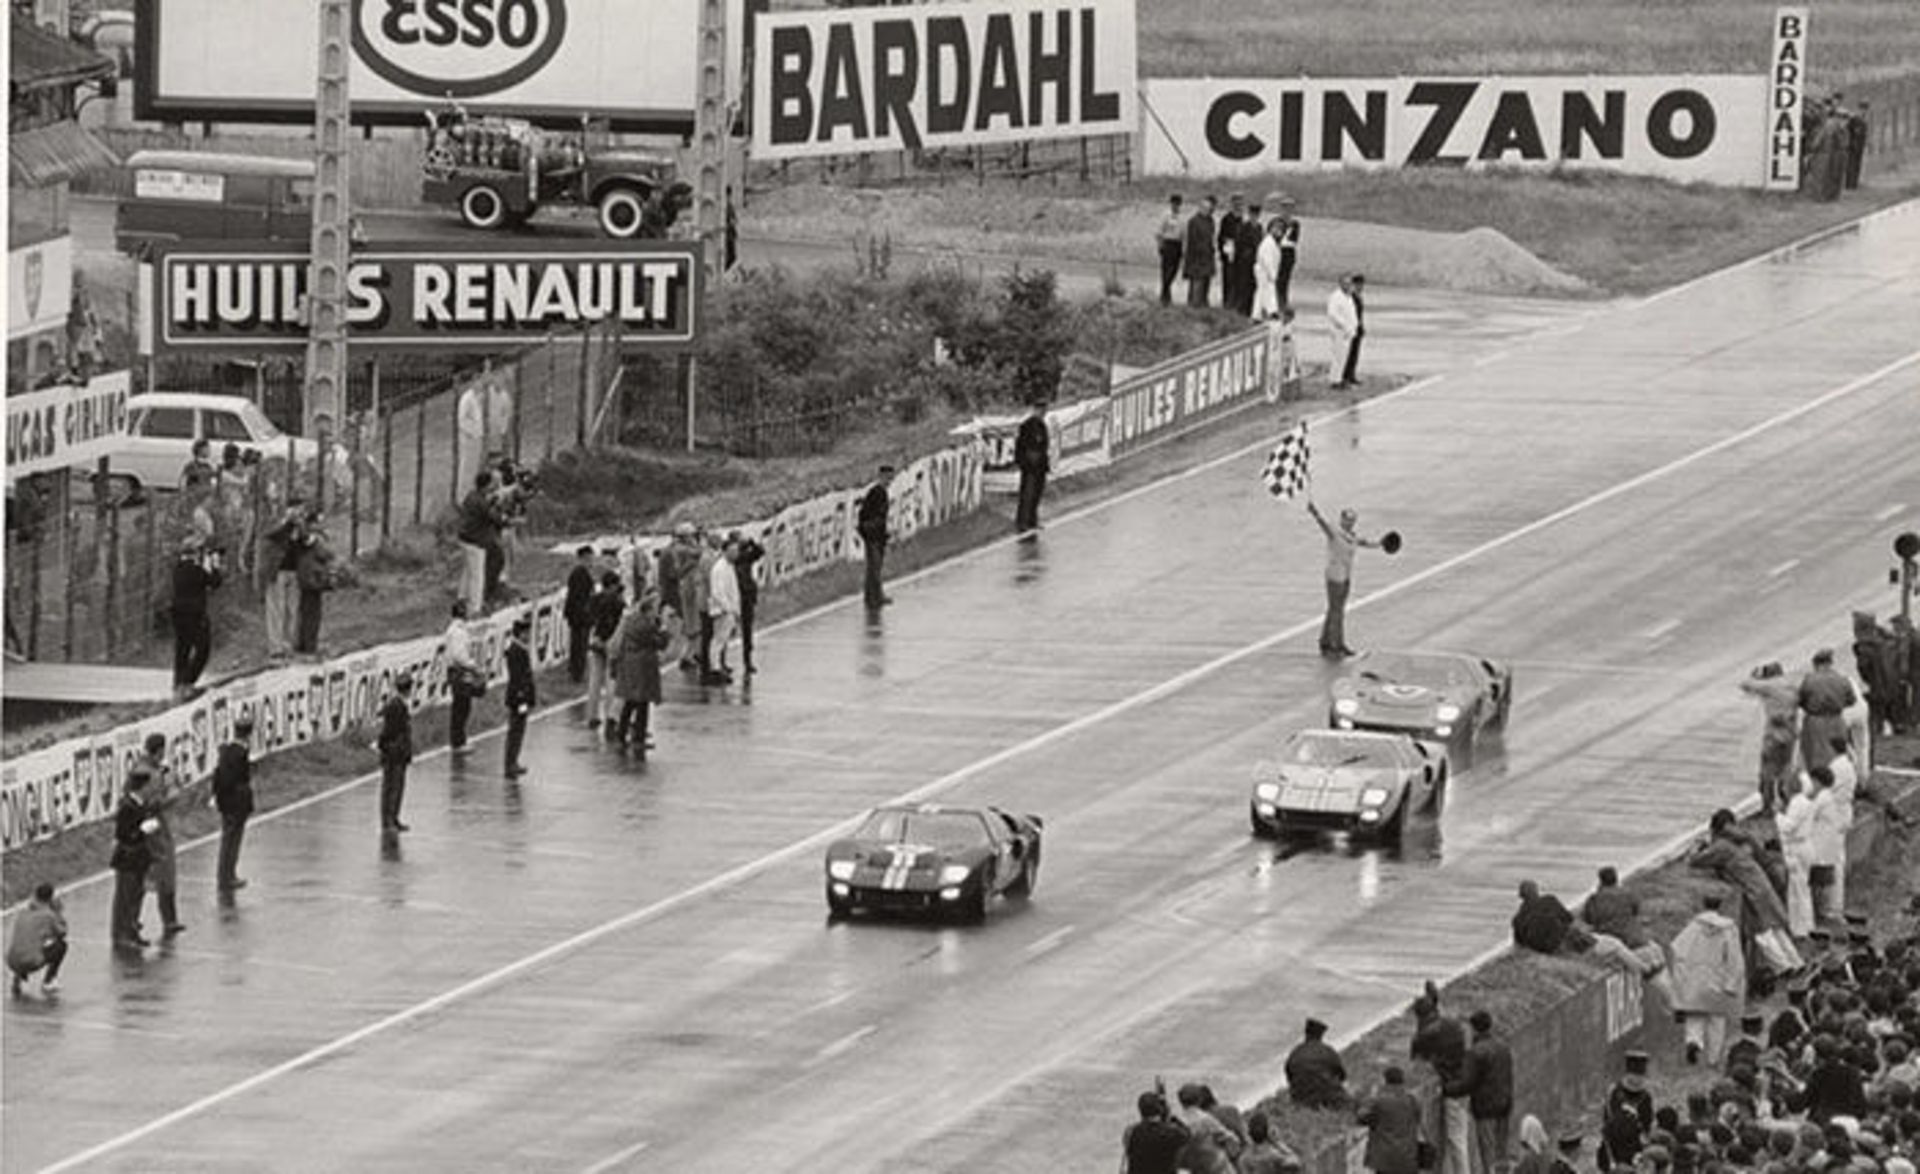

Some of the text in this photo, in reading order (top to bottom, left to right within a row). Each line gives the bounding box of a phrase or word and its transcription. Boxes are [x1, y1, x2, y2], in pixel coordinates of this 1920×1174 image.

[770, 8, 1120, 148] BARDAHL
[1205, 82, 1717, 167] CINZANO
[1771, 15, 1802, 182] BARDAHL
[172, 260, 680, 324] HUILS RENAULT
[1111, 377, 1178, 444] HUILES
[1184, 341, 1266, 415] RENAULT
